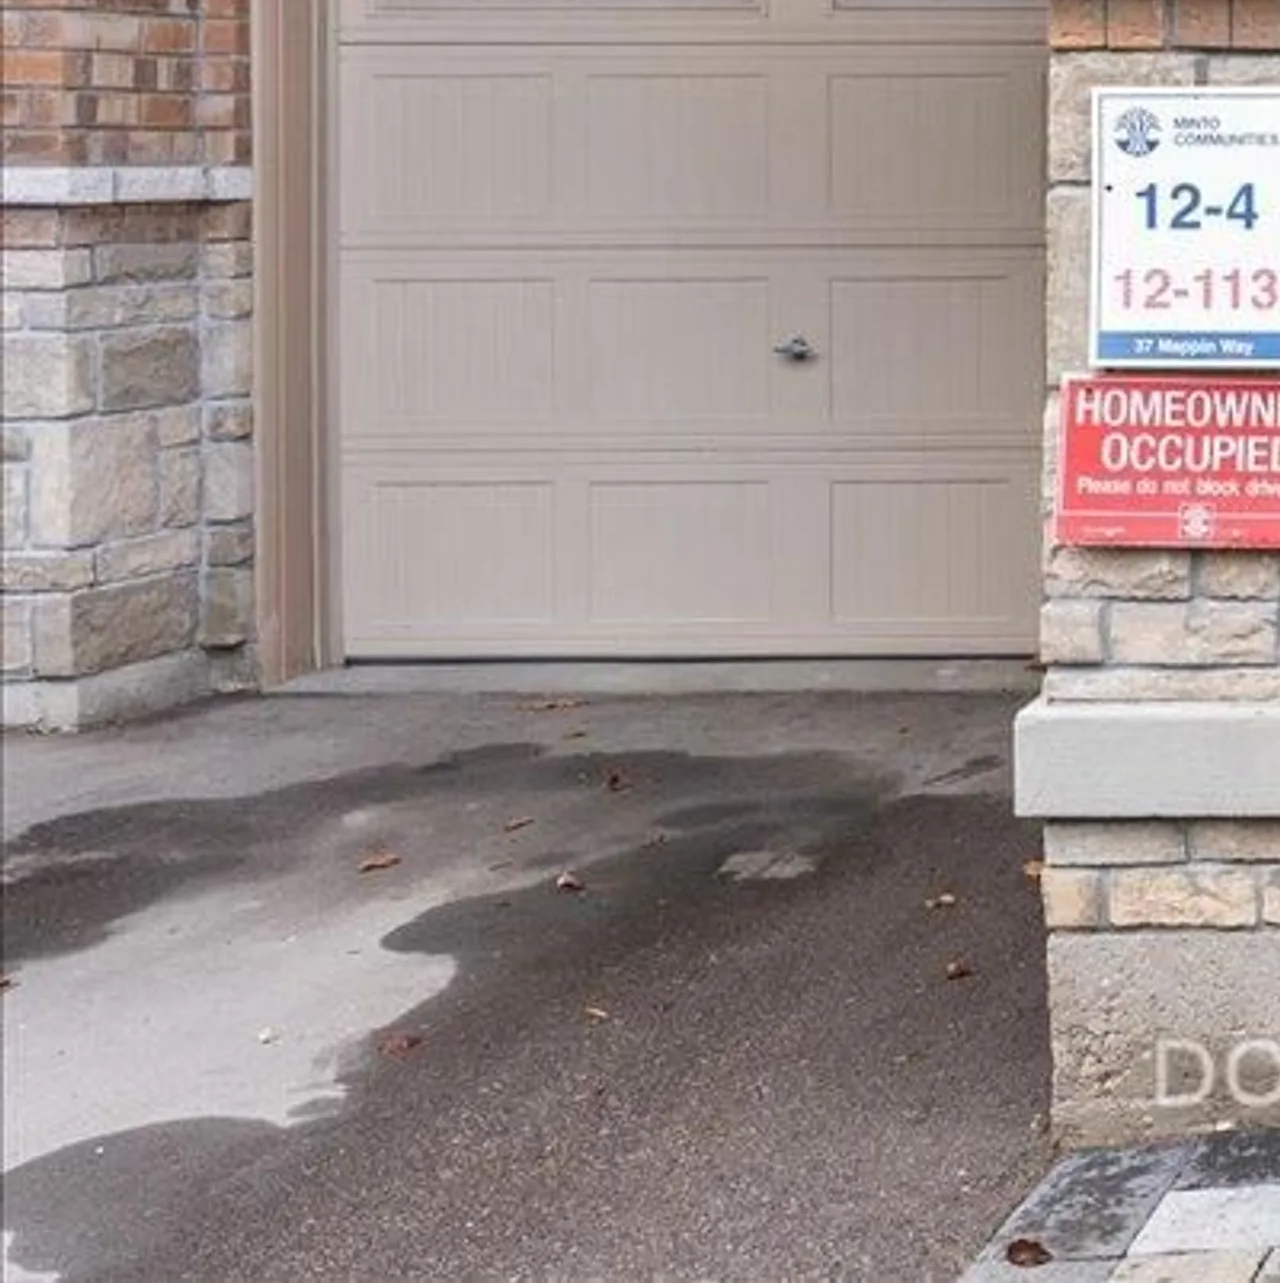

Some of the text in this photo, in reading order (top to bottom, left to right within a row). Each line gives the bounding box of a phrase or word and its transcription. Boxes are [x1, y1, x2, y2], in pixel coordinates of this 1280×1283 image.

[1173, 116, 1221, 130] MINTO
[1174, 132, 1280, 147] COMMUNITIES
[1136, 183, 1259, 230] 12-4
[1114, 268, 1278, 309] 12-113
[1134, 338, 1253, 356] 37 Mappin Way
[1077, 477, 1132, 494] Please
[1136, 478, 1157, 494] do
[1162, 478, 1191, 494] not
[1197, 479, 1240, 496] block
